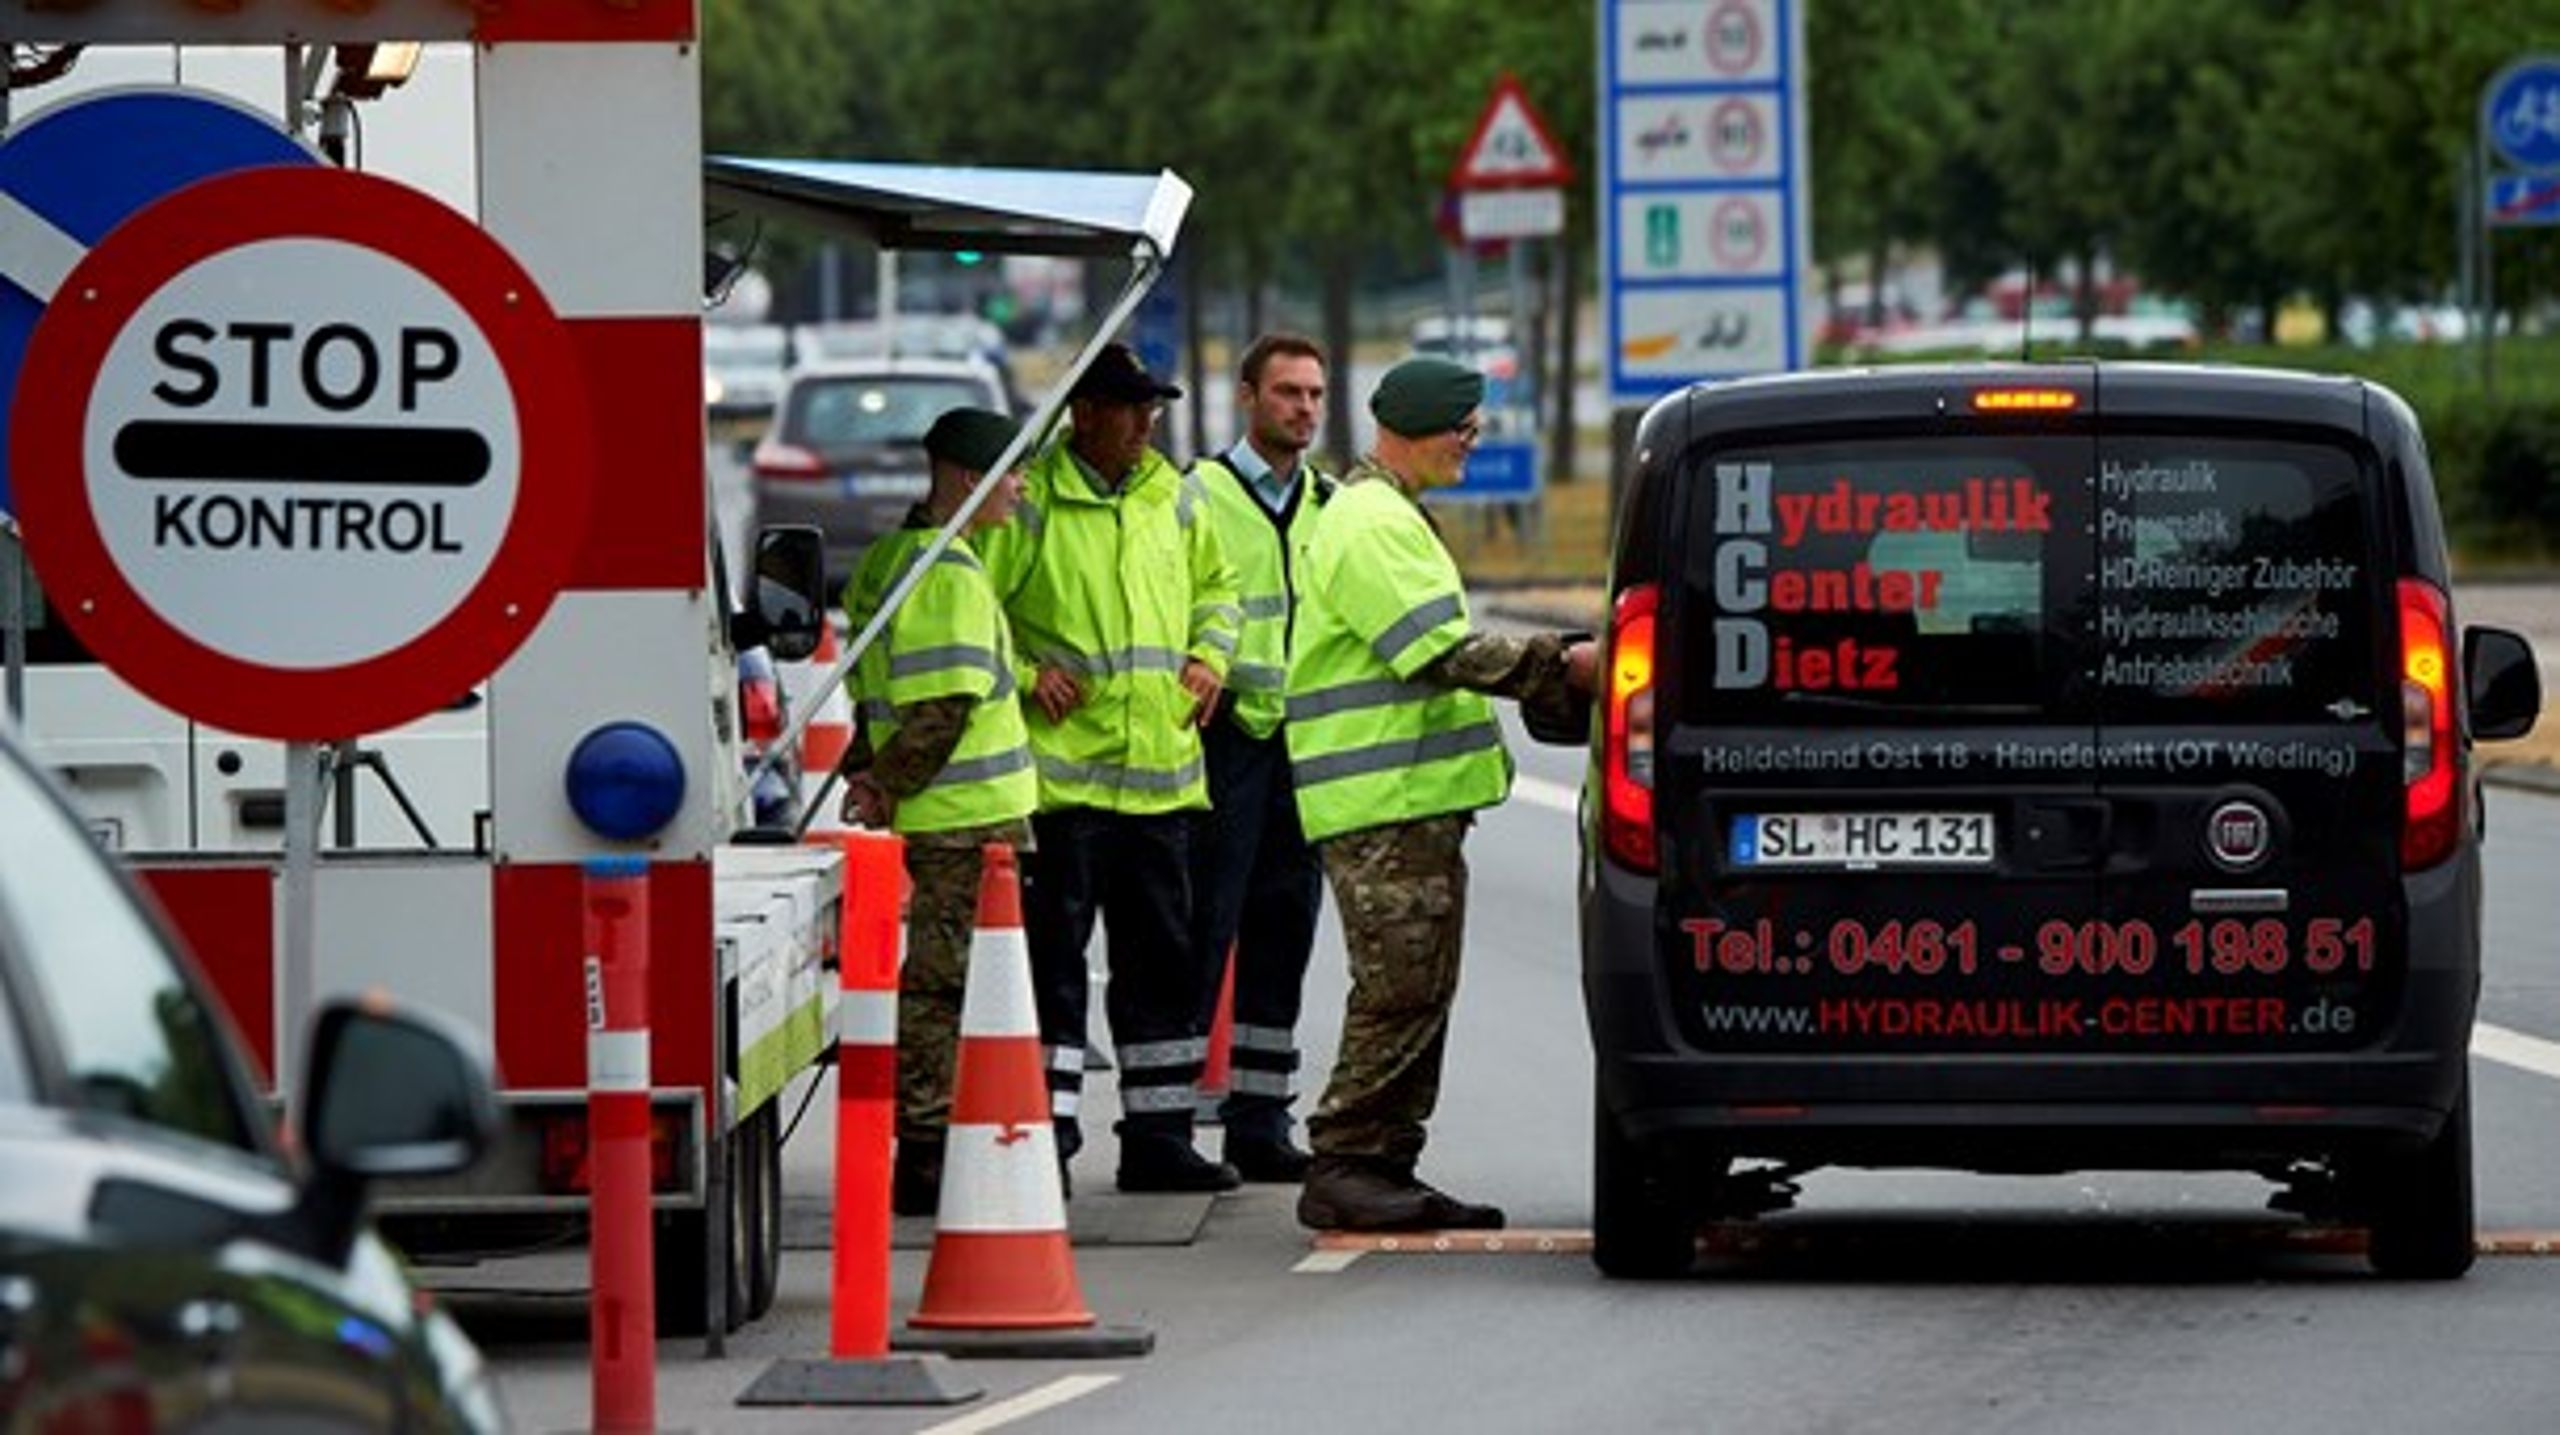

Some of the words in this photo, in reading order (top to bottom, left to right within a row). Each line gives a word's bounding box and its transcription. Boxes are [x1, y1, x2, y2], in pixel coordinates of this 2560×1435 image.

[152, 318, 462, 413] STOP
[1714, 463, 2053, 546] Hydraulik
[2102, 460, 2217, 500] Hydraulik
[154, 494, 464, 554] KONTROL
[1714, 539, 1943, 614] Center
[2102, 556, 2249, 597] HD-Reiniger
[2253, 555, 2358, 590] Zubehör
[1714, 617, 1898, 690] Dietz
[2102, 652, 2293, 686] Antriebstechnik
[1702, 743, 1860, 773] Heideland
[1867, 742, 1923, 769] Ost
[1935, 741, 1969, 769] 18
[1995, 741, 2156, 769] Handewitt
[2163, 741, 2219, 773] (OT
[2225, 741, 2356, 777] Weding)
[1761, 817, 1815, 857] SL
[1846, 816, 1899, 856] HC
[1910, 816, 1990, 856] 131
[1680, 917, 1813, 974] Tel.:
[1828, 918, 1978, 975] 0461
[2036, 917, 2158, 975] 900
[2172, 917, 2289, 974] 198
[2304, 916, 2376, 972] 51
[1702, 998, 2357, 1037] www.HYDRAULIK-CENTER.de
